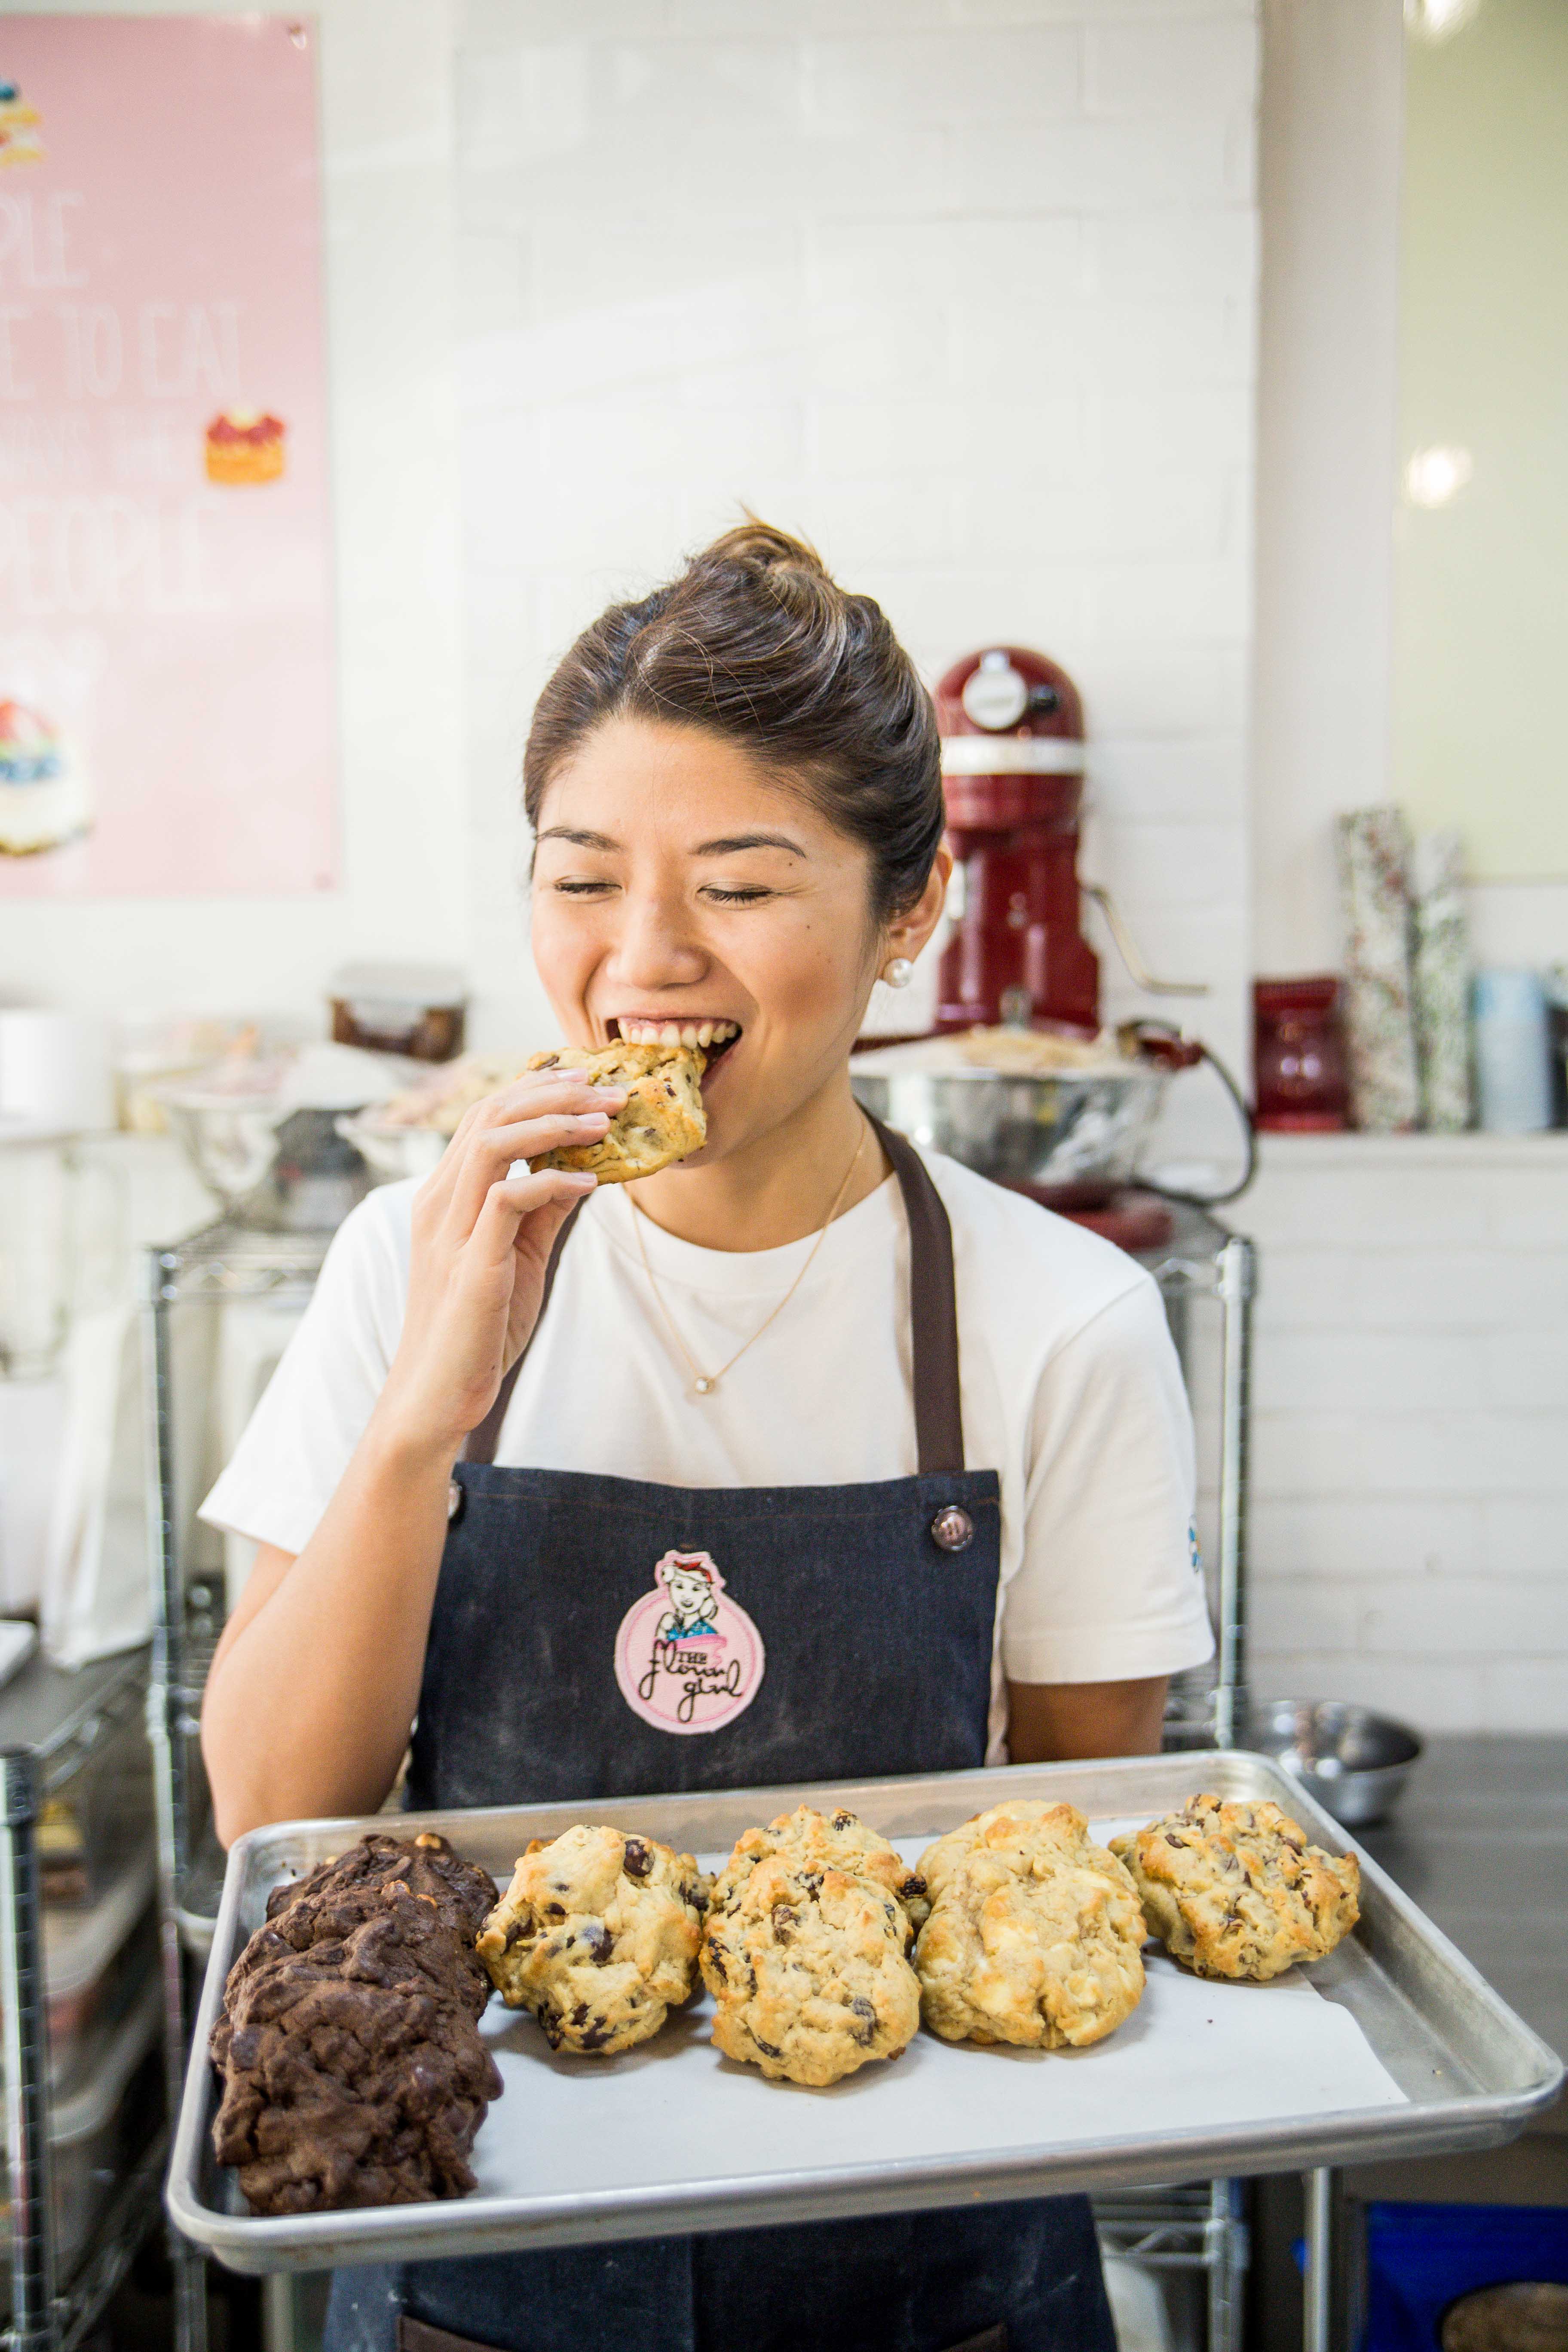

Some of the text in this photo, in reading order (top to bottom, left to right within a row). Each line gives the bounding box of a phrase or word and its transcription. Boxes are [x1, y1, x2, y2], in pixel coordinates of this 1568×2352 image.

[55, 303, 123, 400] TO
[137, 299, 244, 399] EAT
[639, 1639, 726, 1700] flour
[678, 1651, 708, 1664] THE
[677, 1659, 743, 1723] girl
